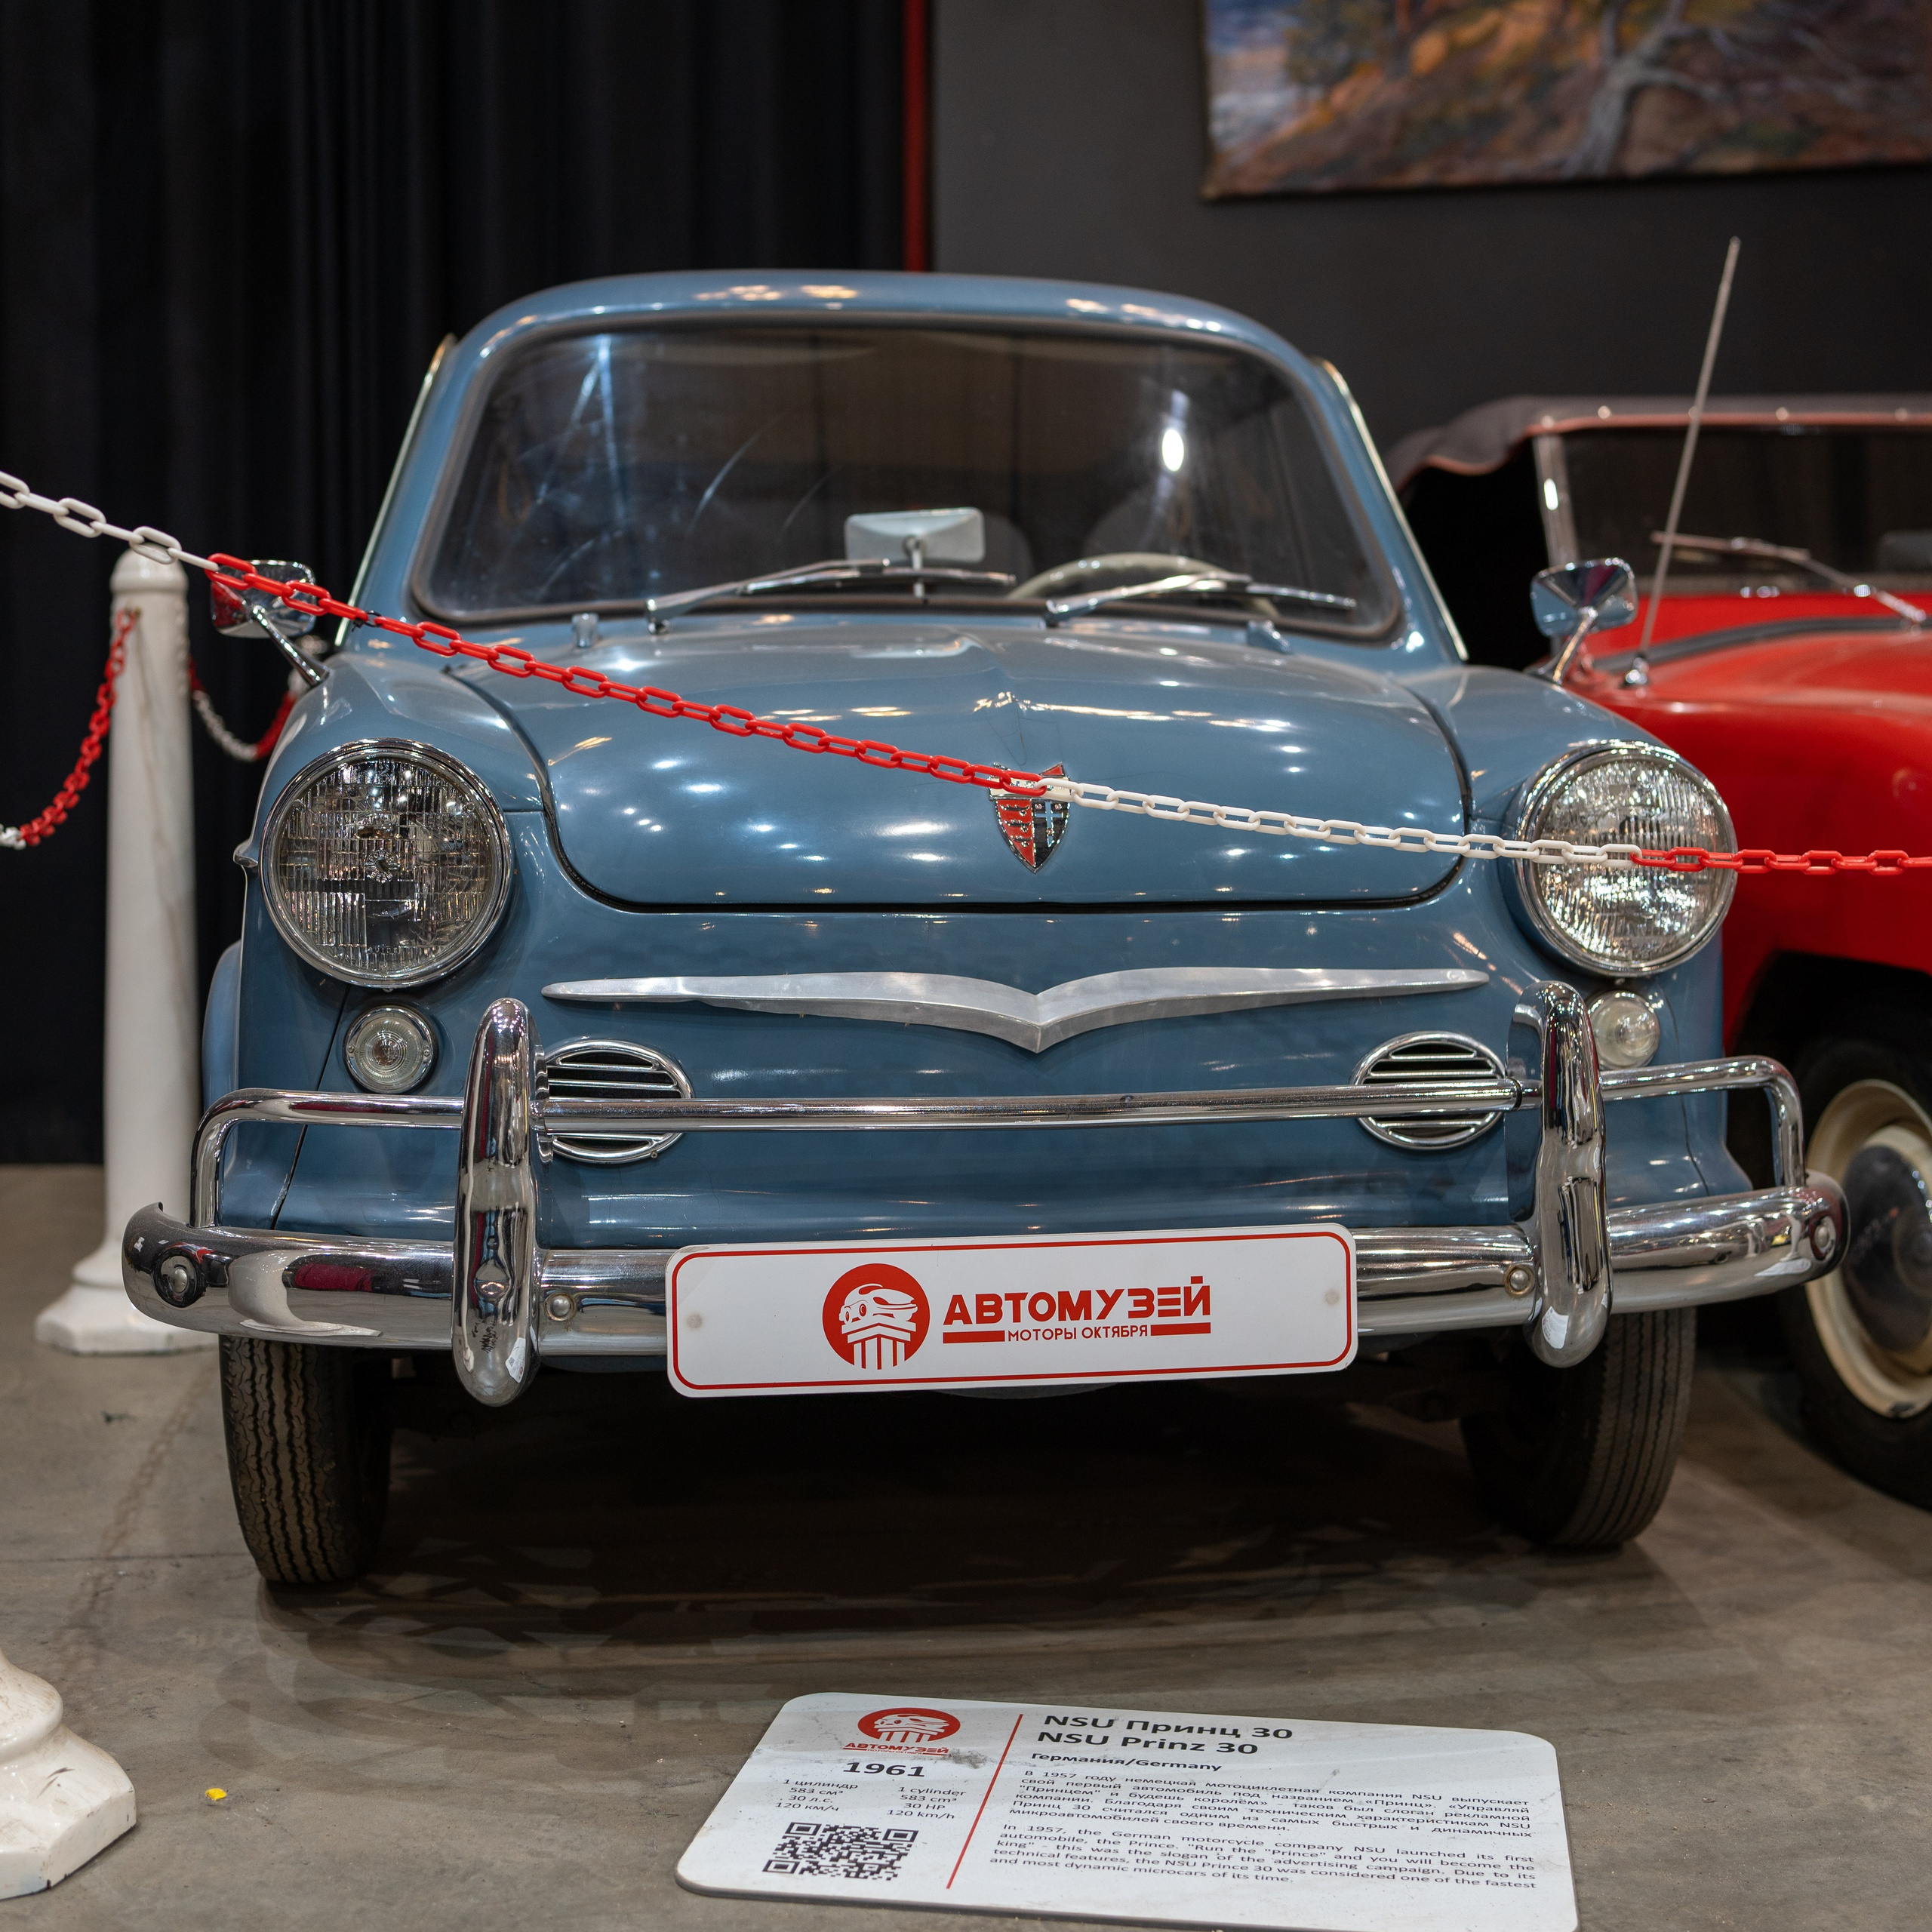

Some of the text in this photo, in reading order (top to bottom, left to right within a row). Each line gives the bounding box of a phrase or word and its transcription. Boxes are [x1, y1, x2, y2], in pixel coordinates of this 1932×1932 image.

[368, 850, 395, 863] POWER
[943, 1276, 1211, 1326] АВТОМУЗЕЙ
[1008, 1324, 1148, 1341] МОТОРЫ ОКТЯБРЯ
[1044, 1715, 1293, 1740] NSU Принц 30
[844, 1743, 949, 1754] АВТОМУЗЕЙ
[1037, 1731, 1258, 1755] NSU Prinz 30
[843, 1761, 925, 1777] 1961
[1031, 1752, 1223, 1772] Германия/Germany
[795, 1780, 859, 1790] цилиндр
[909, 1788, 967, 1797] cylinder
[1125, 1778, 1196, 1786] немецкая
[1205, 1783, 1321, 1794] мотоциклетная
[1328, 1790, 1402, 1798] компания
[1452, 1797, 1529, 1805] выпускает
[1132, 1786, 1222, 1795] автомобиль
[1271, 1793, 1353, 1803] названием
[917, 1811, 955, 1820] km/h
[1105, 1798, 1182, 1809] Благодаря
[1248, 1808, 1346, 1819] техническим
[1356, 1815, 1489, 1827] характеристикам
[1128, 1792, 1184, 1801] будешь
[1444, 1812, 1530, 1821] рекламной
[1009, 1809, 1159, 1823] микроавтомобилей
[1013, 1801, 1061, 1810] Принц
[1102, 1807, 1168, 1816] считался
[1332, 1820, 1398, 1829] быстрых
[1431, 1827, 1532, 1838] динамичных
[1112, 1831, 1171, 1840] German
[1182, 1836, 1264, 1846] motorcycle
[1275, 1842, 1343, 1852] company
[1397, 1848, 1466, 1858] launched
[994, 1849, 1060, 1858] technical
[1201, 1862, 1249, 1870] Prince
[1311, 1870, 1395, 1880] considered
[1485, 1879, 1536, 1888] fastest
[1161, 1850, 1208, 1860] slogan
[1273, 1859, 1358, 1870] advertising
[1440, 1860, 1501, 1869] become
[1065, 1862, 1128, 1872] dynamic
[1134, 1867, 1207, 1877] microcars
